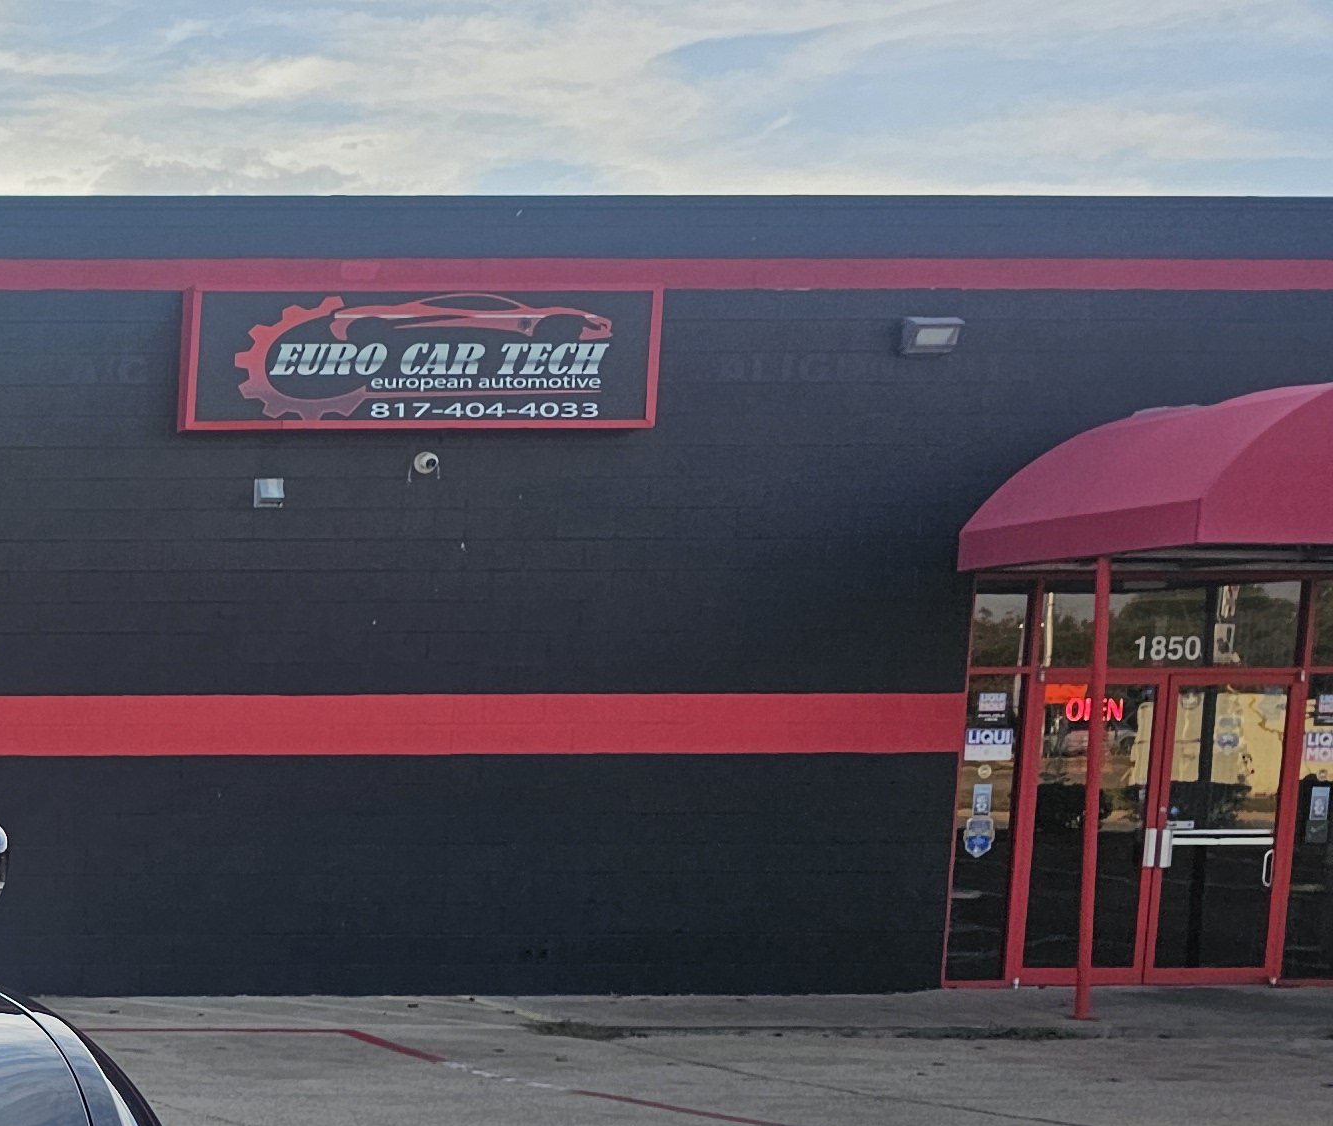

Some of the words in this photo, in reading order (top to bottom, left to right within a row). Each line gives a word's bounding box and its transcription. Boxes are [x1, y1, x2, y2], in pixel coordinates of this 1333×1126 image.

[269, 342, 388, 376] EURO
[399, 342, 486, 375] CAR
[497, 342, 610, 375] TECH
[370, 376, 473, 392] european
[478, 374, 602, 389] automotive
[370, 402, 599, 418] 817-404-4033
[1134, 635, 1202, 661] 1850
[1066, 697, 1124, 721] ON
[968, 729, 1011, 744] LIQUI
